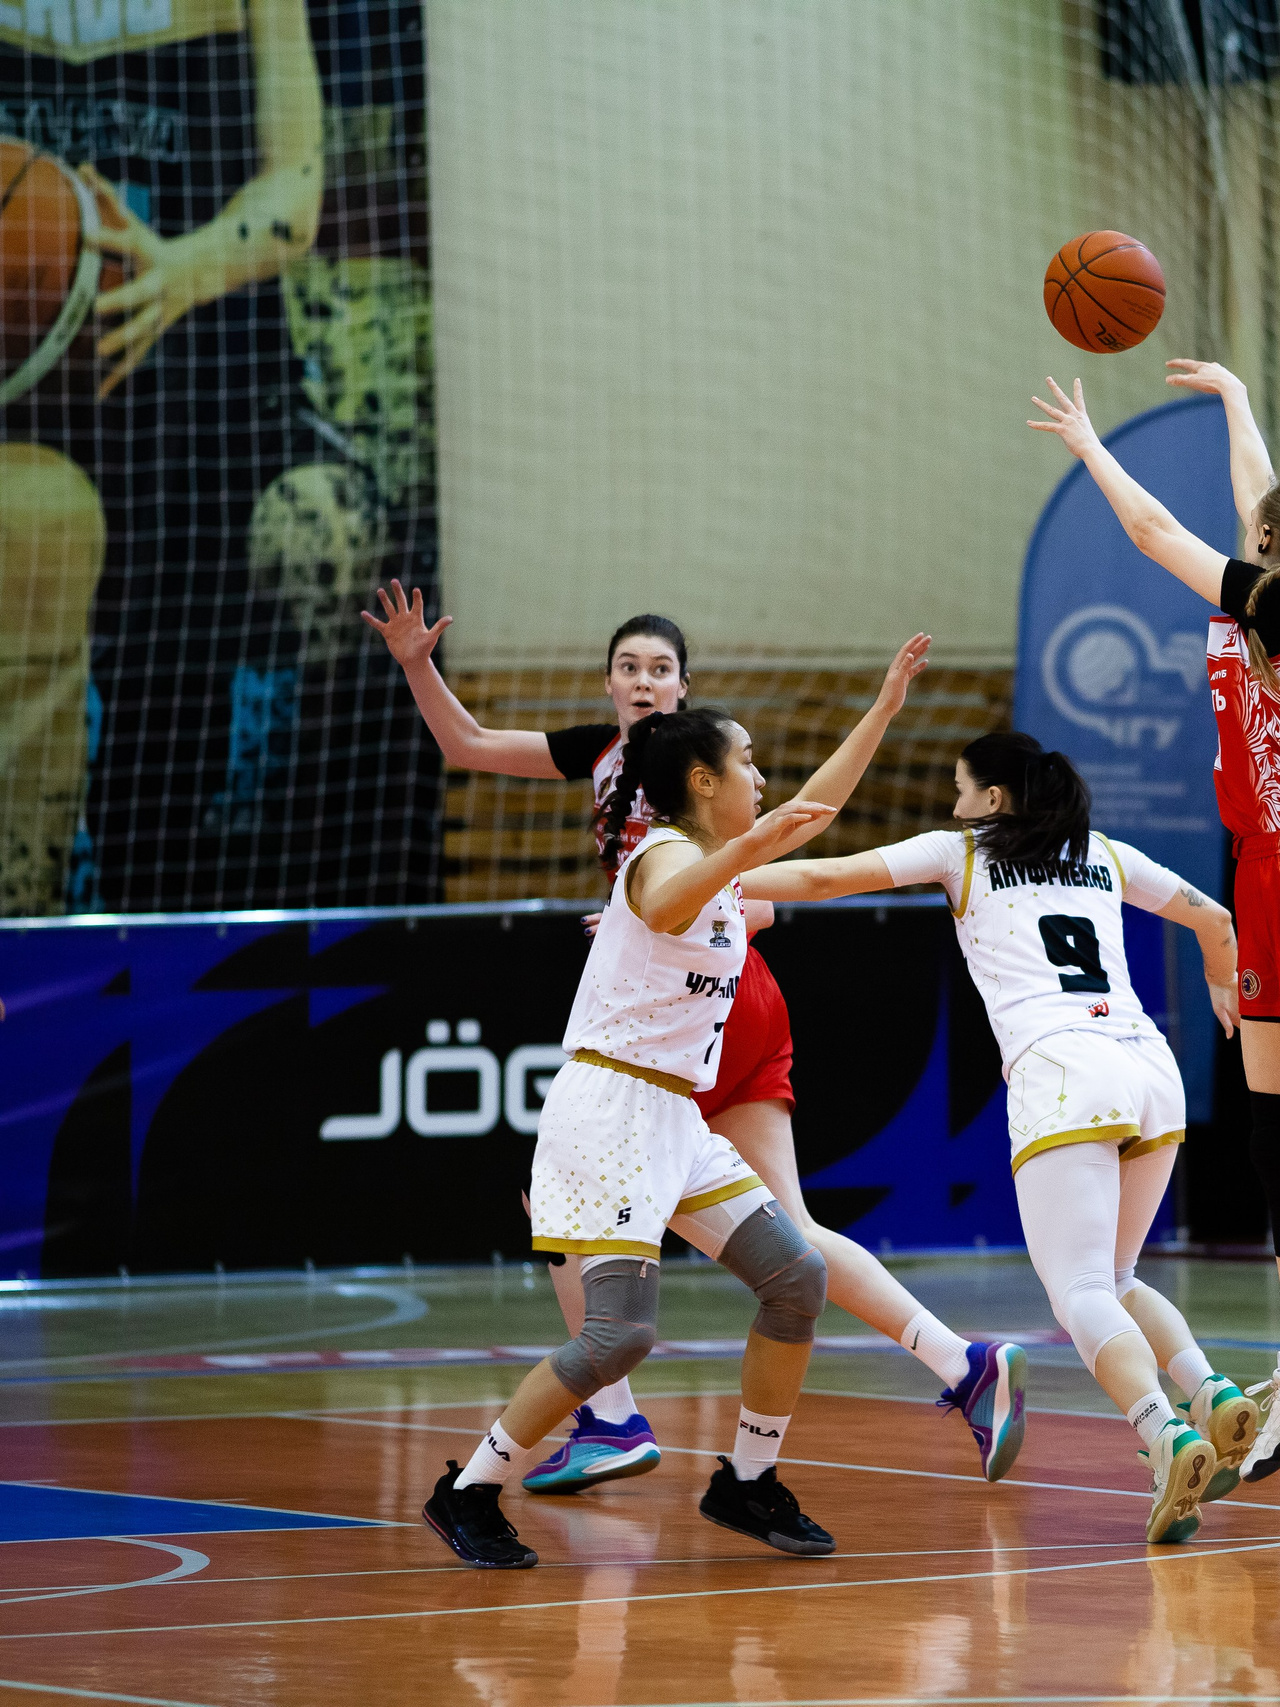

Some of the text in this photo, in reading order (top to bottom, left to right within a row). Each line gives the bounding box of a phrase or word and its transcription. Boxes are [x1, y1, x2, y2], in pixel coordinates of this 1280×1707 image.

[1038, 913, 1111, 994] 9
[319, 1018, 563, 1142] JÖG
[616, 1206, 632, 1226] 5
[739, 1419, 780, 1439] FILA
[487, 1430, 511, 1462] ILA
